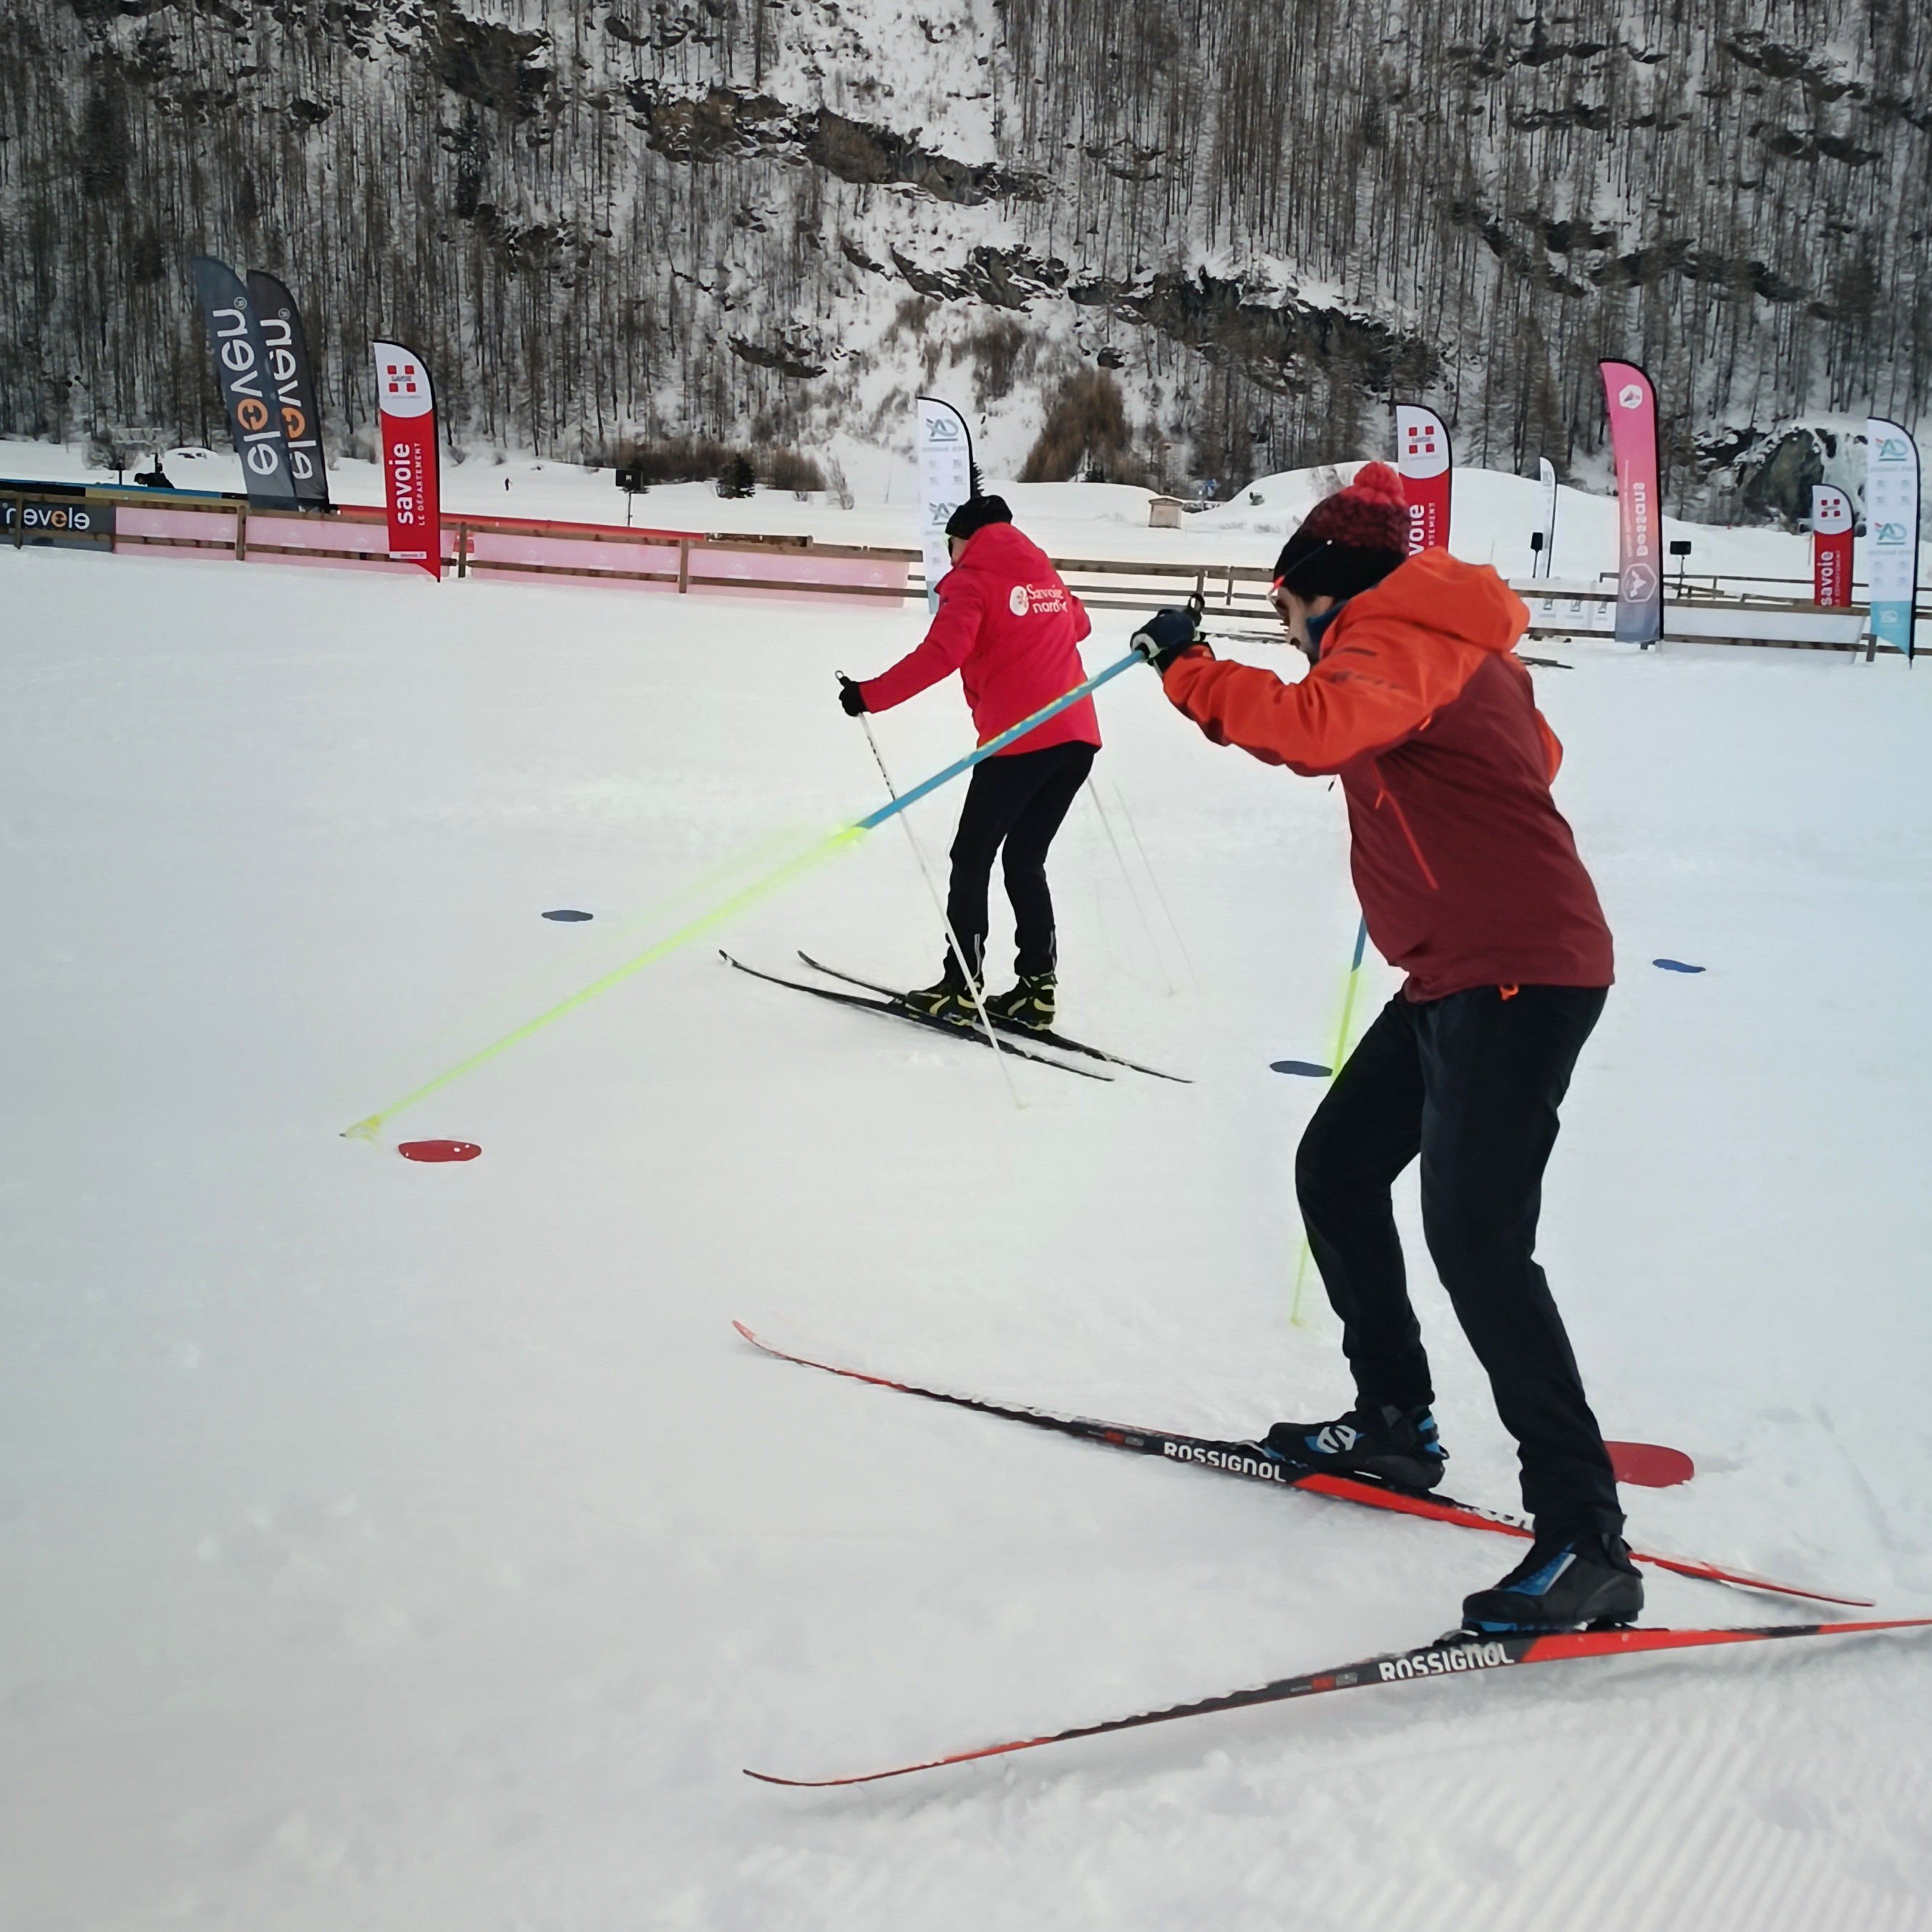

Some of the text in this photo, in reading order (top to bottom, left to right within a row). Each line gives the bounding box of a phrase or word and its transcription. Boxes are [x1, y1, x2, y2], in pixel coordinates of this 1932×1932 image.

[389, 443, 414, 525] savoie
[1408, 504, 1425, 556] voie
[1163, 1441, 1287, 1483] ROSSIGNOL
[1378, 1641, 1515, 1681] ROSSIGNOL
